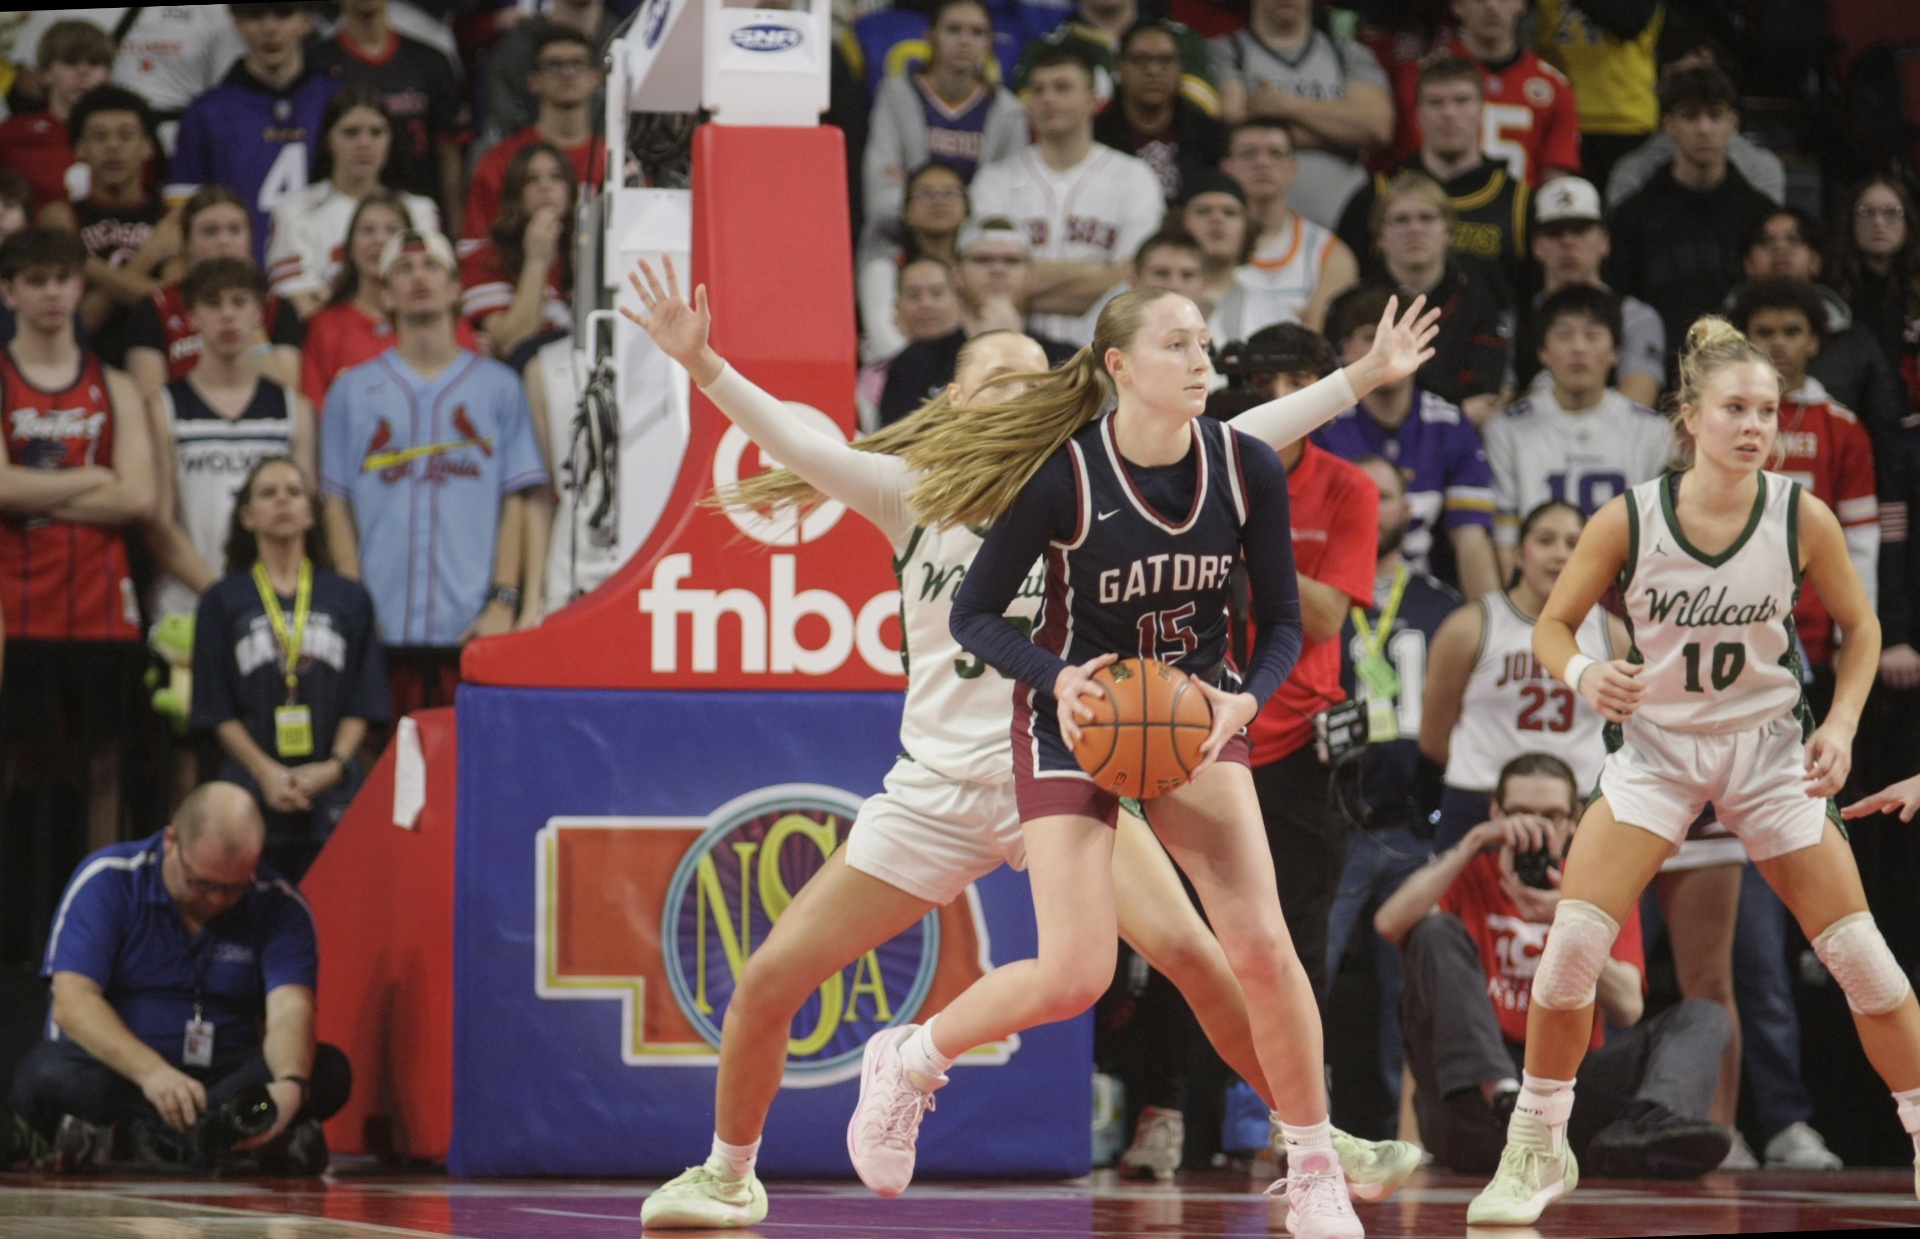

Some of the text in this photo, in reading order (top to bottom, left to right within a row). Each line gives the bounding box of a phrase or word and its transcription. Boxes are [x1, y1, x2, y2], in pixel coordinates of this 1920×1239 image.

[257, 141, 308, 213] 4
[181, 449, 262, 474] WOLV
[1100, 553, 1233, 604] GATORS
[1645, 585, 1780, 628] Wildcats
[1136, 601, 1199, 666] 15
[1682, 641, 1746, 693] 10
[1516, 685, 1575, 734] 23
